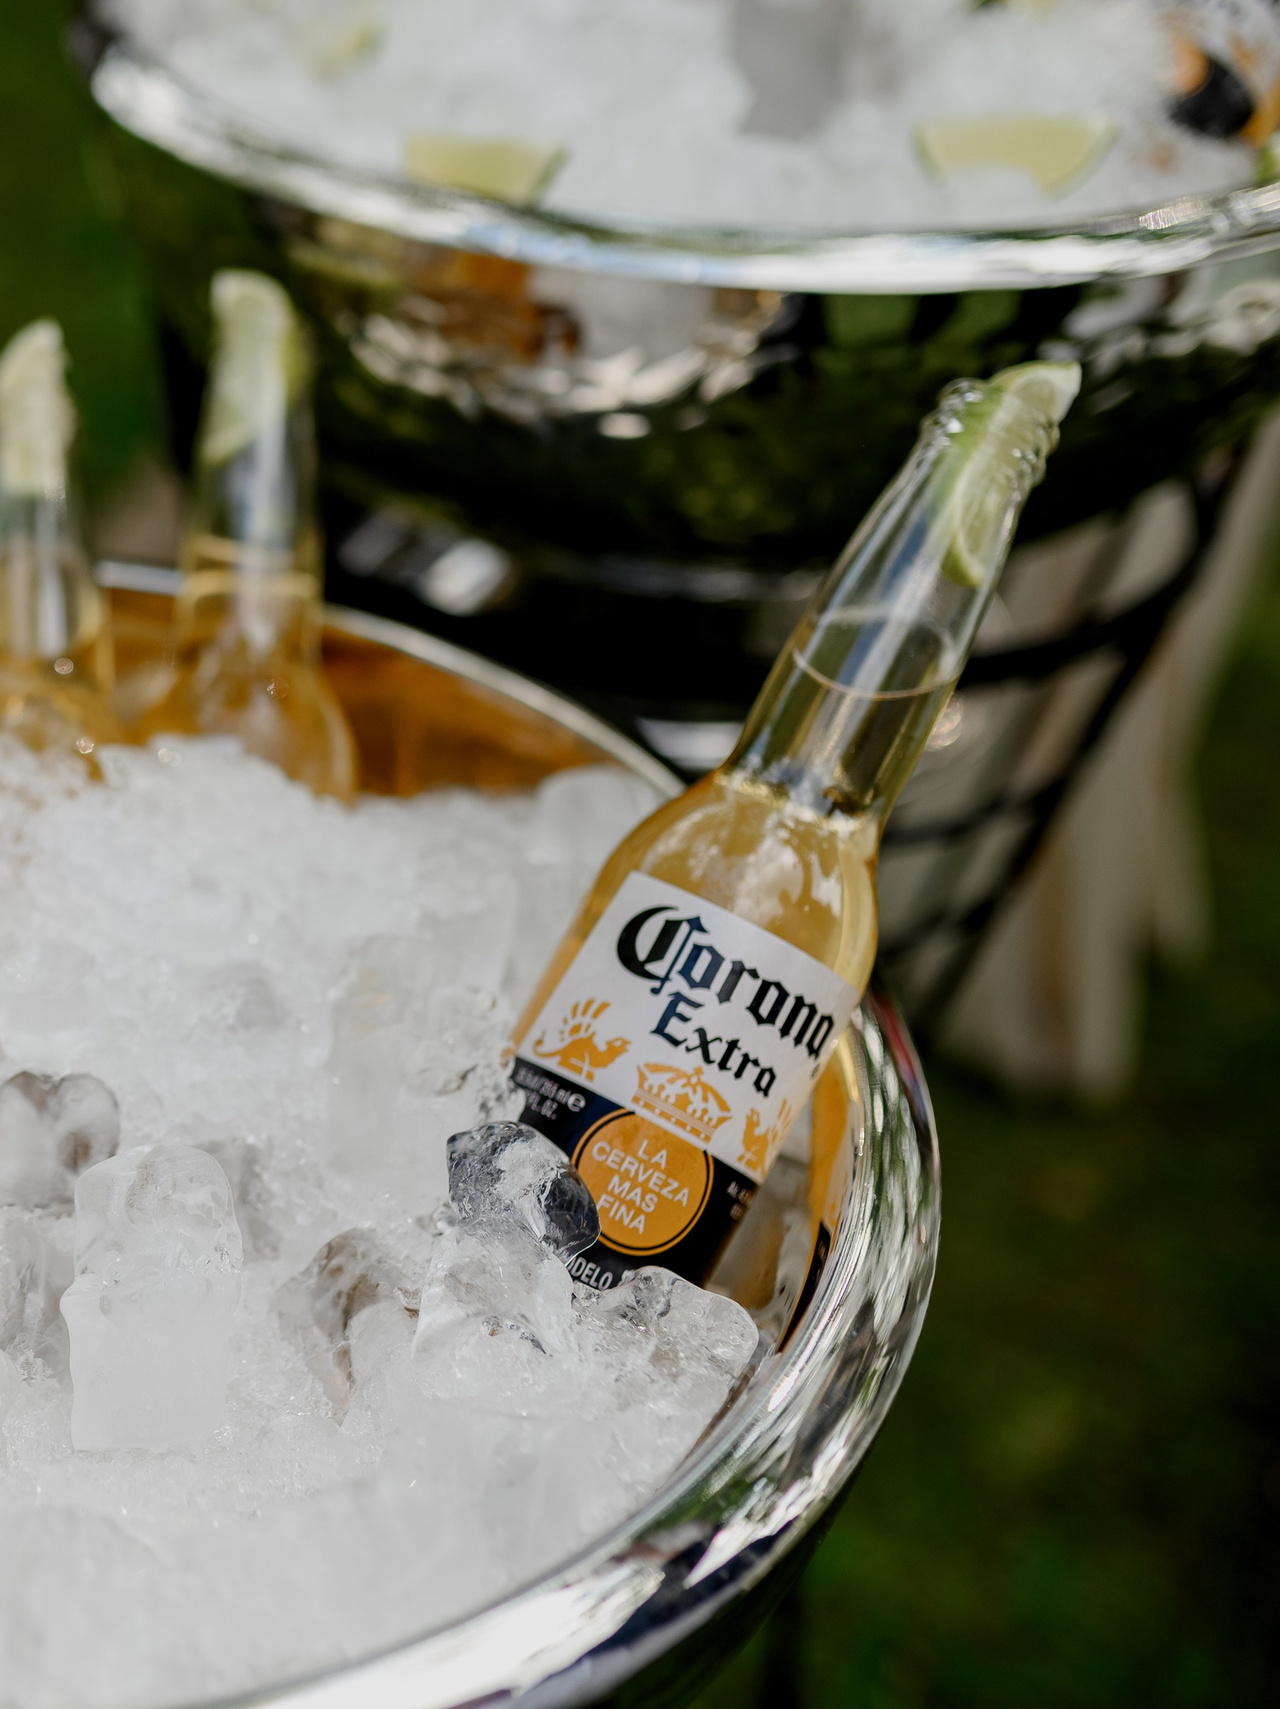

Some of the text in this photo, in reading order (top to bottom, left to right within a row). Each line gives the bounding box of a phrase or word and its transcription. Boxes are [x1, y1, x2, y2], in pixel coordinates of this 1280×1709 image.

[616, 905, 835, 1061] Corona
[650, 990, 777, 1099] Extra
[591, 1141, 690, 1208] CERVEZA
[637, 1139, 668, 1170] LA
[596, 1193, 647, 1236] FINA
[606, 1174, 658, 1214] MAS
[565, 1256, 614, 1291] DELO
